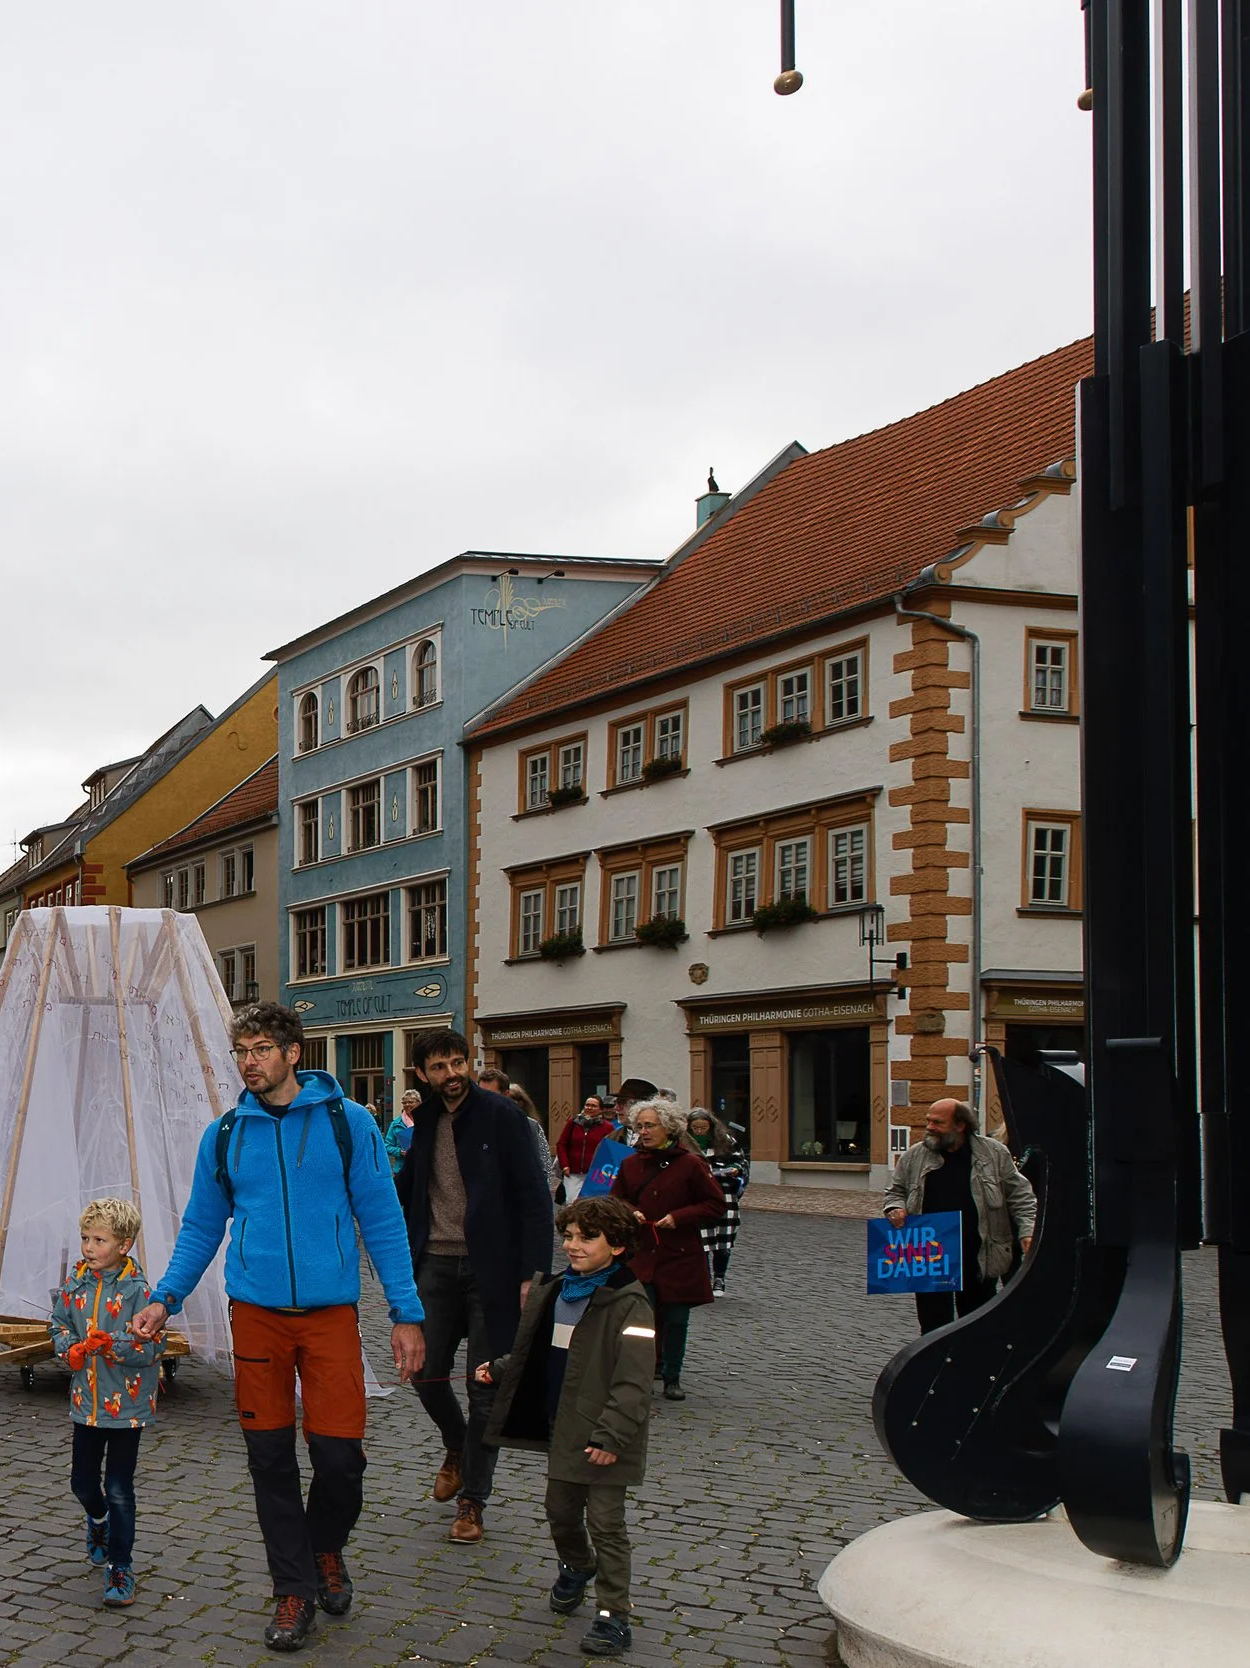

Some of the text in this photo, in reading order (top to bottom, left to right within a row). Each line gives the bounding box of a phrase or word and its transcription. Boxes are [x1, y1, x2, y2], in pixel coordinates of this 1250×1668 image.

[470, 608, 512, 626] TEMPLE
[336, 997, 361, 1017] TEMPLE
[1014, 997, 1047, 1006] THÜRINGEN
[699, 1003, 874, 1025] THÜRINGEN PHILHARMONIE GOTHA-EISENACH
[491, 1023, 612, 1040] THÜRINGEN PHILHARMONIE GOTHA-EISENACH
[887, 1226, 936, 1249] WIR
[884, 1241, 944, 1265] SIND
[877, 1254, 950, 1279] DABEI
